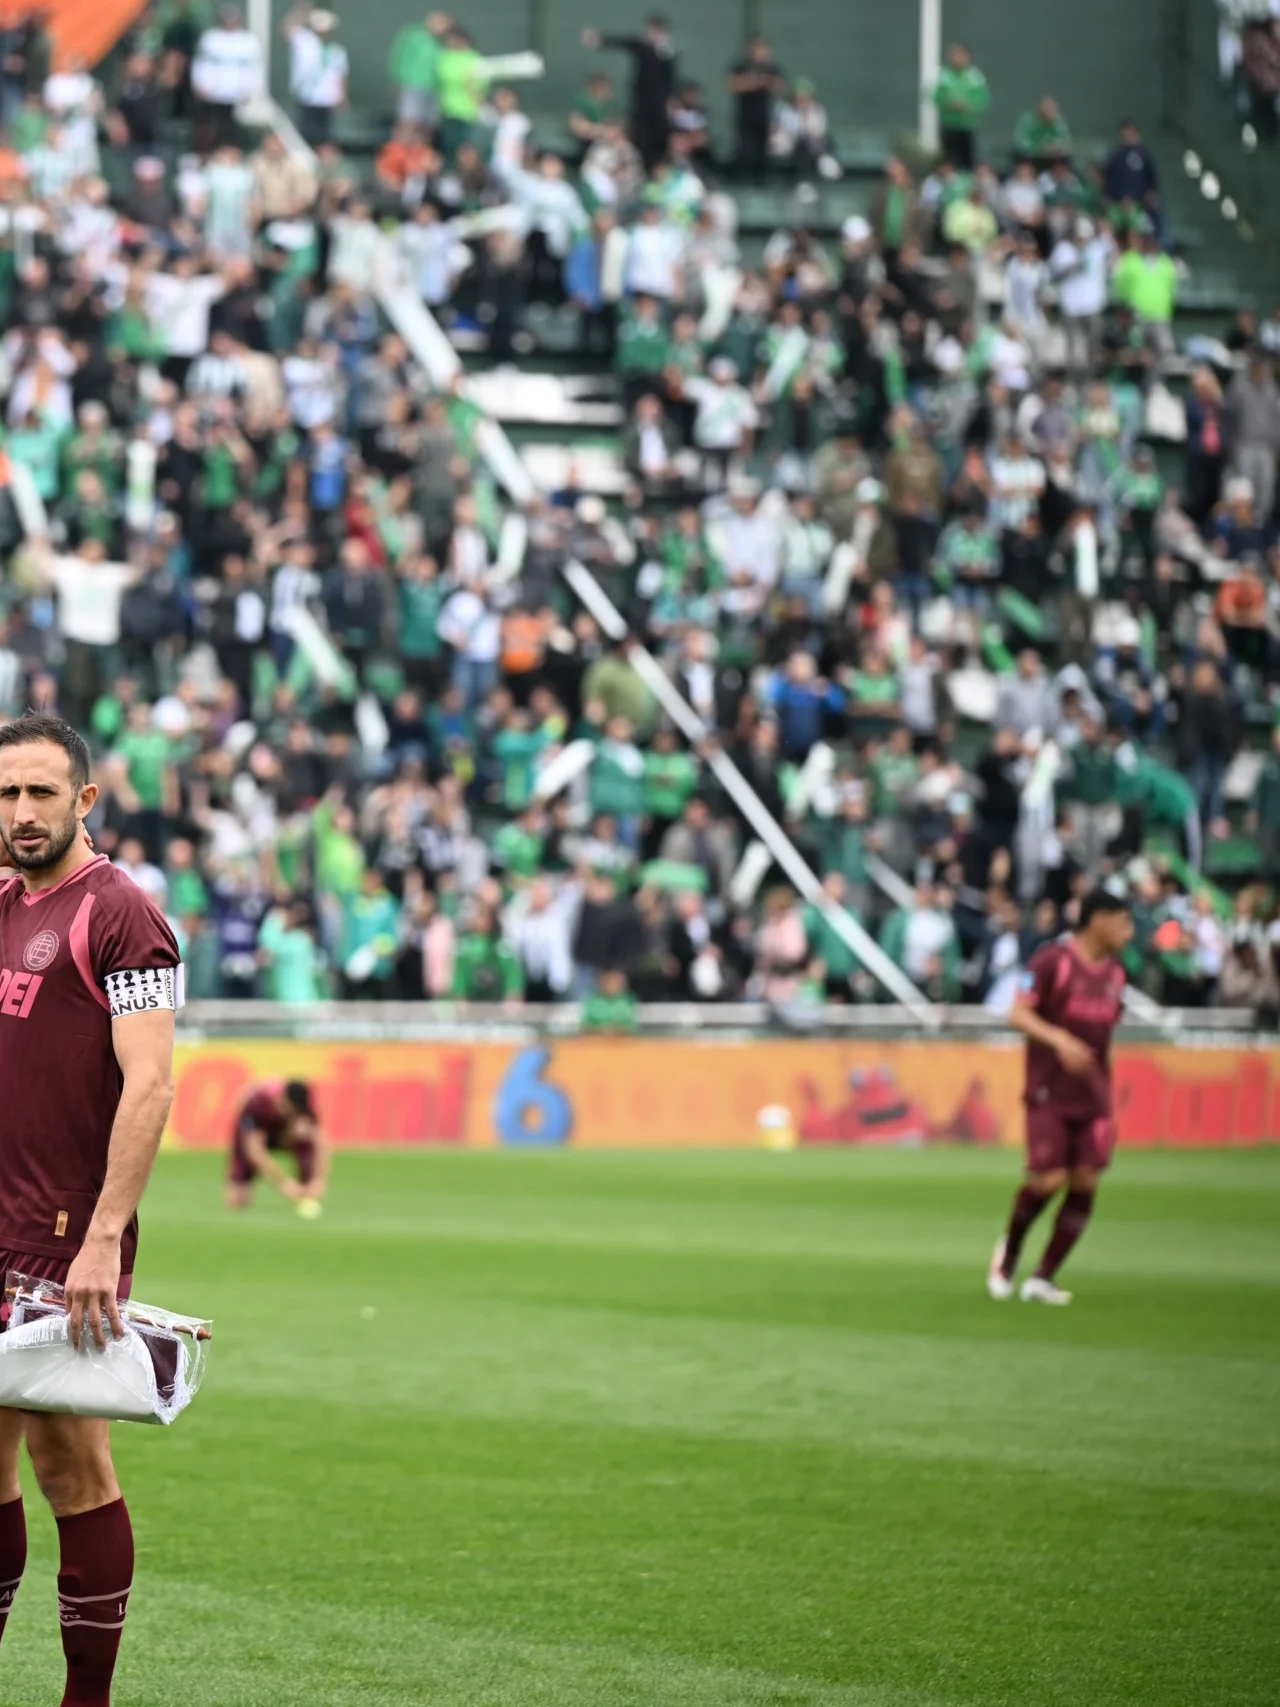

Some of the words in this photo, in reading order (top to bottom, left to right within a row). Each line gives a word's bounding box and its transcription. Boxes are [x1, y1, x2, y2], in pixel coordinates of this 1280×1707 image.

[111, 995, 159, 1018] ANUS
[170, 1054, 475, 1150] Qini
[493, 1045, 574, 1148] 6
